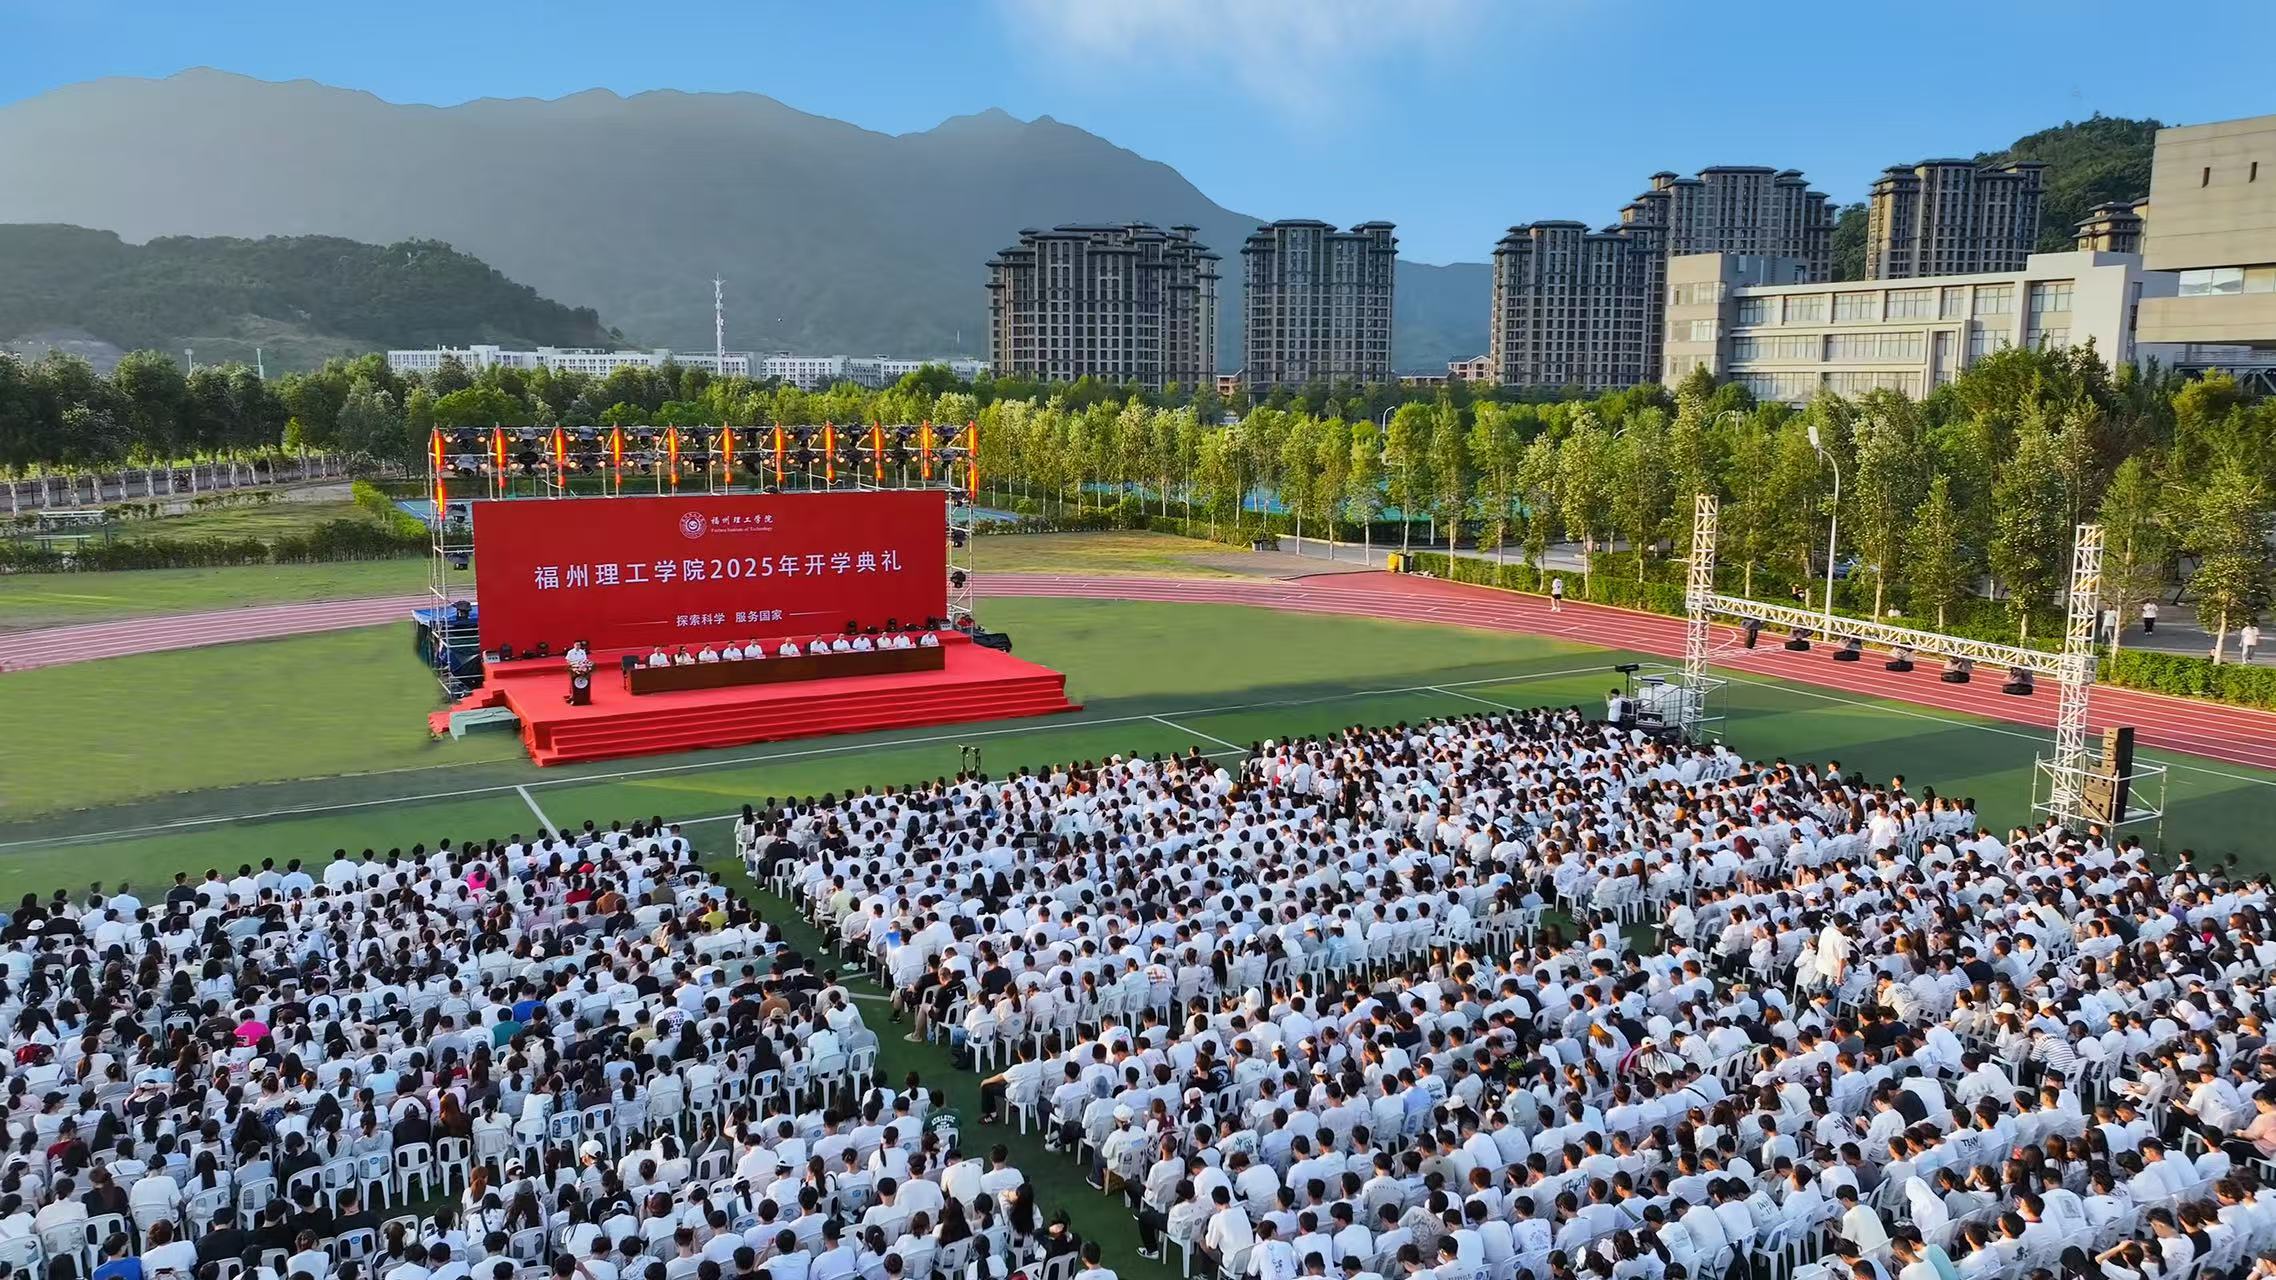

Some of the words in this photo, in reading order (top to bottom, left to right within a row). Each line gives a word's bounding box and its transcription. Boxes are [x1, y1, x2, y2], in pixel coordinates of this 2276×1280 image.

[711, 515, 773, 525] 福州理工学院
[534, 549, 903, 590] 福州理工学院2025年开学典礼
[676, 614, 726, 628] 探索科学
[735, 609, 783, 624] 服务国家
